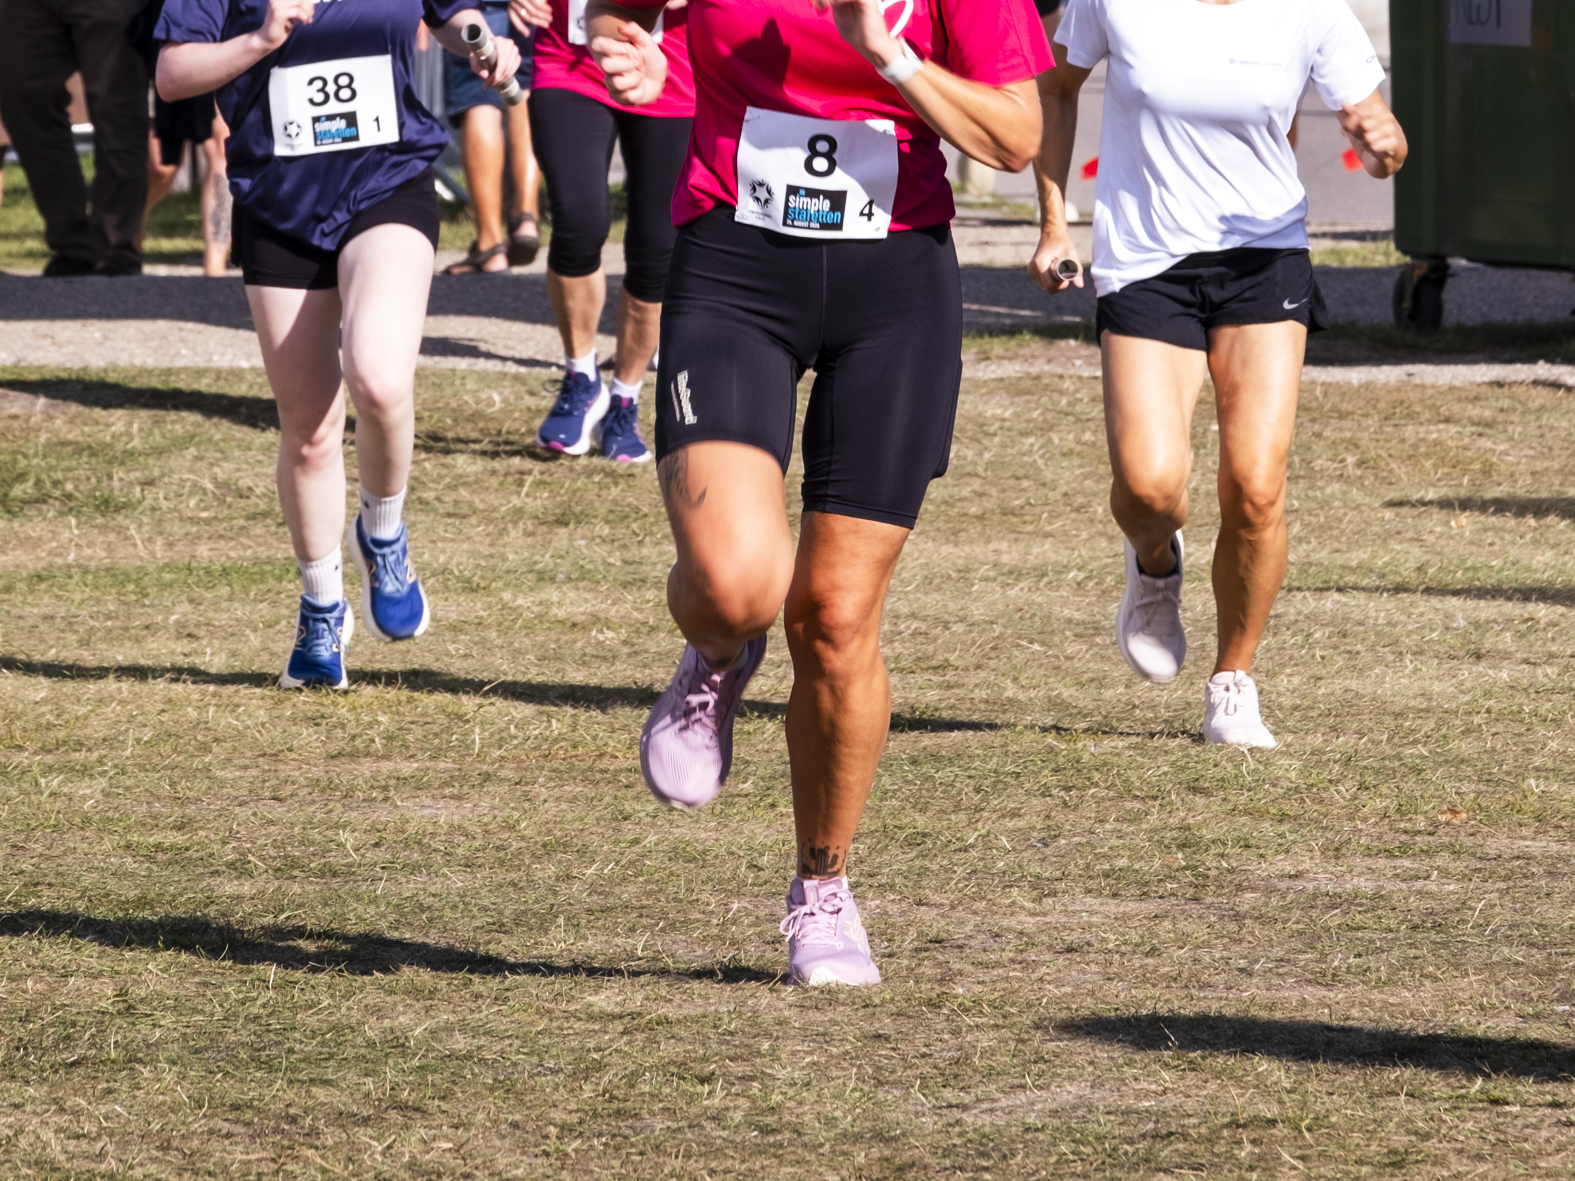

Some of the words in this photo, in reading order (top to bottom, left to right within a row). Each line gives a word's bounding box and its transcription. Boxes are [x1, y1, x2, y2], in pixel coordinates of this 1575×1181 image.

[306, 72, 358, 107] 38
[314, 116, 347, 135] simple
[372, 115, 381, 132] 1
[803, 133, 838, 178] 8
[788, 193, 831, 215] simple
[859, 198, 875, 222] 4
[787, 207, 842, 224] stafetten
